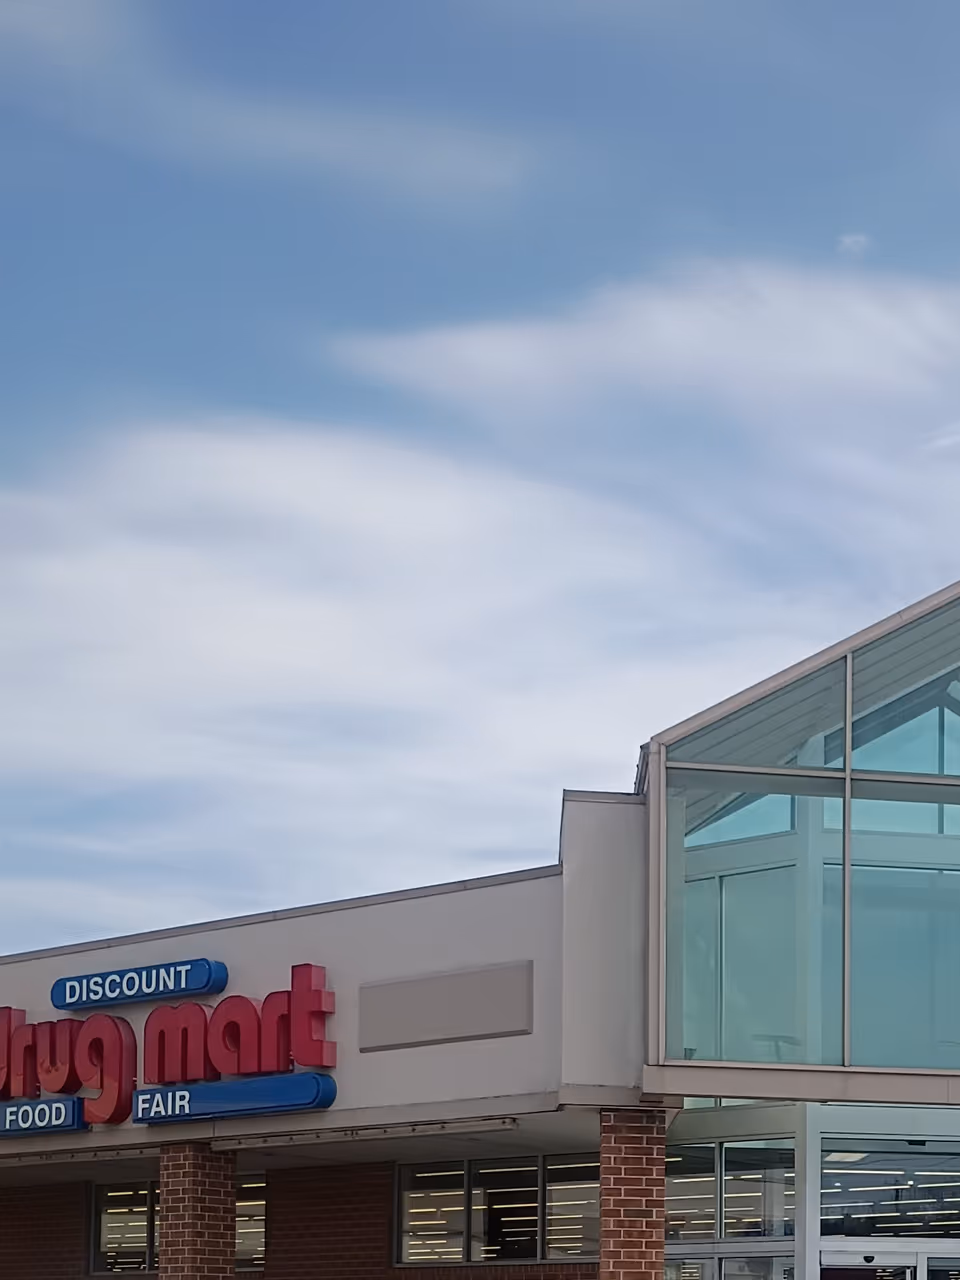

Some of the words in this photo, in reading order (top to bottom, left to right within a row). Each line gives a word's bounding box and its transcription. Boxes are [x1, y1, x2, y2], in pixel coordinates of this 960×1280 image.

[65, 964, 192, 1004] DISCOUNT
[144, 963, 337, 1085] mart
[5, 1103, 66, 1129] FOOD
[137, 1090, 191, 1118] FAIR
